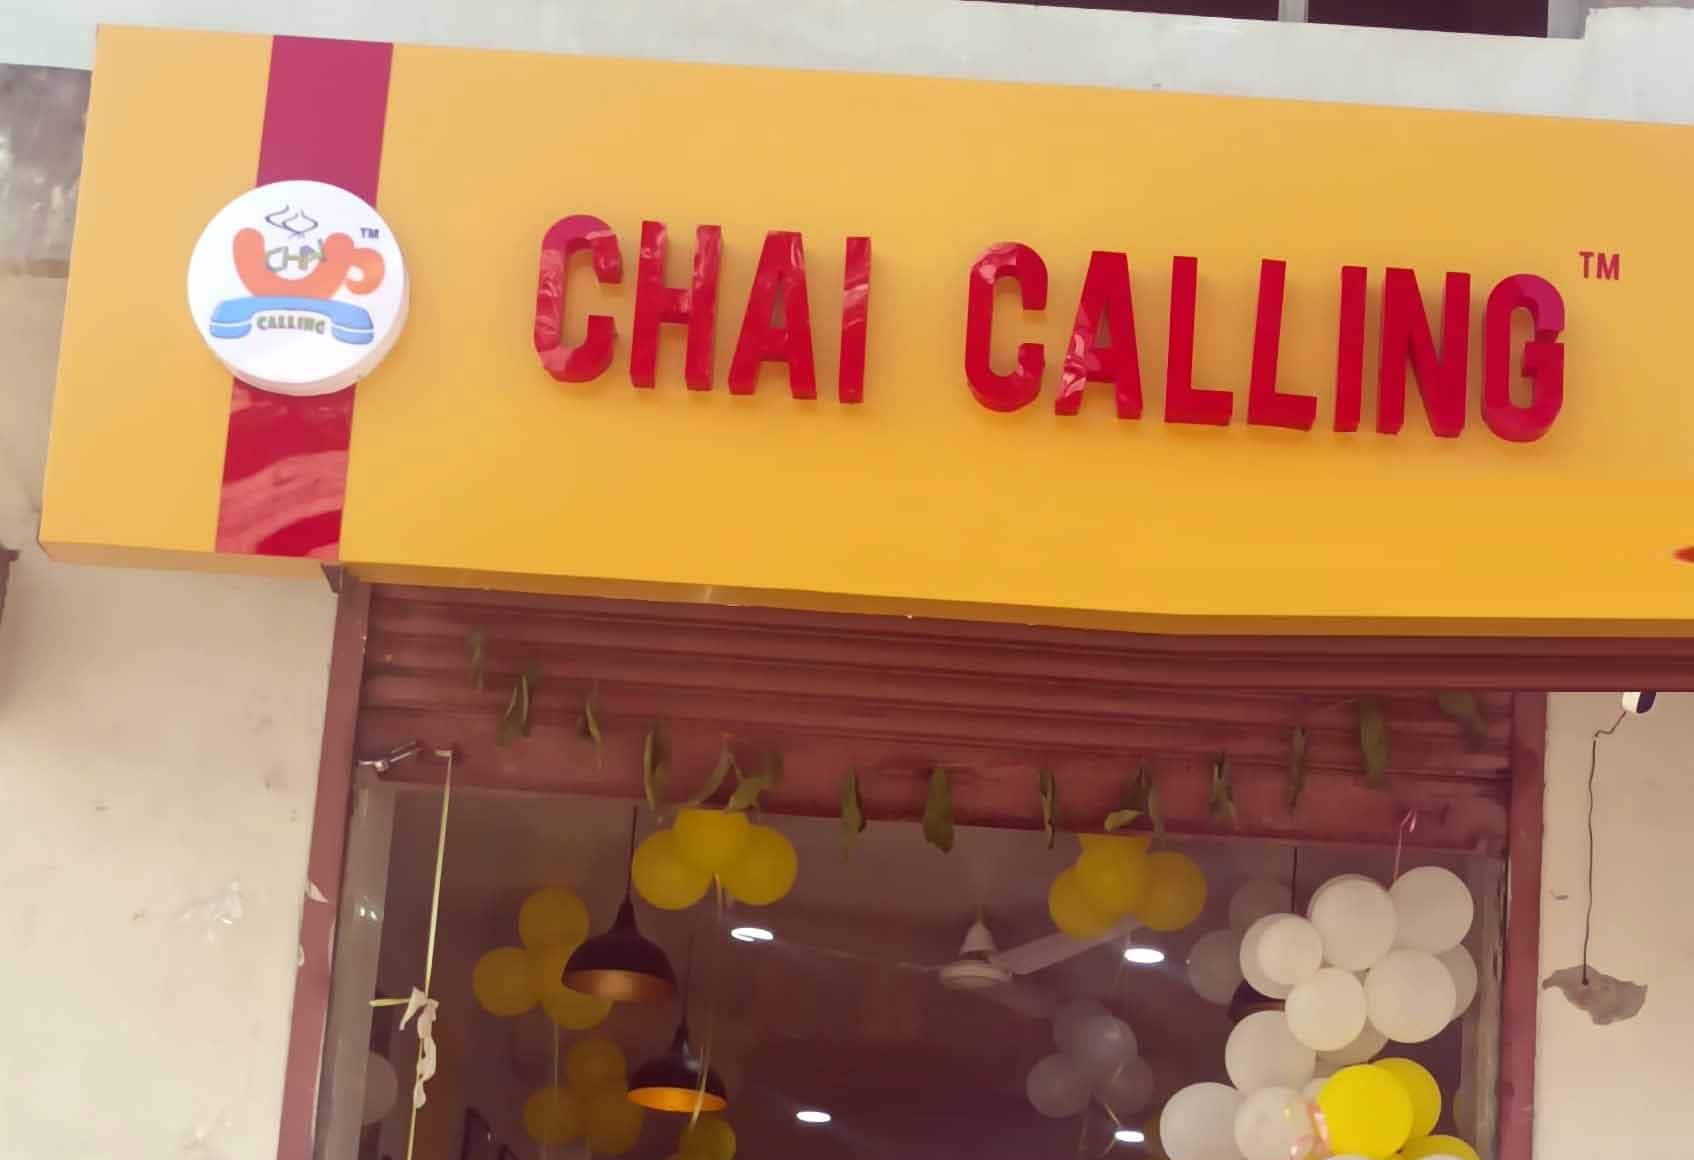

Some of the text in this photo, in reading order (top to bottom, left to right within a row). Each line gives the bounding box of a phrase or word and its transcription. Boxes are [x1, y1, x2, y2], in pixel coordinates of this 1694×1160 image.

[256, 315, 326, 335] CALLING
[534, 214, 1621, 443] CHAI CALLING TM
